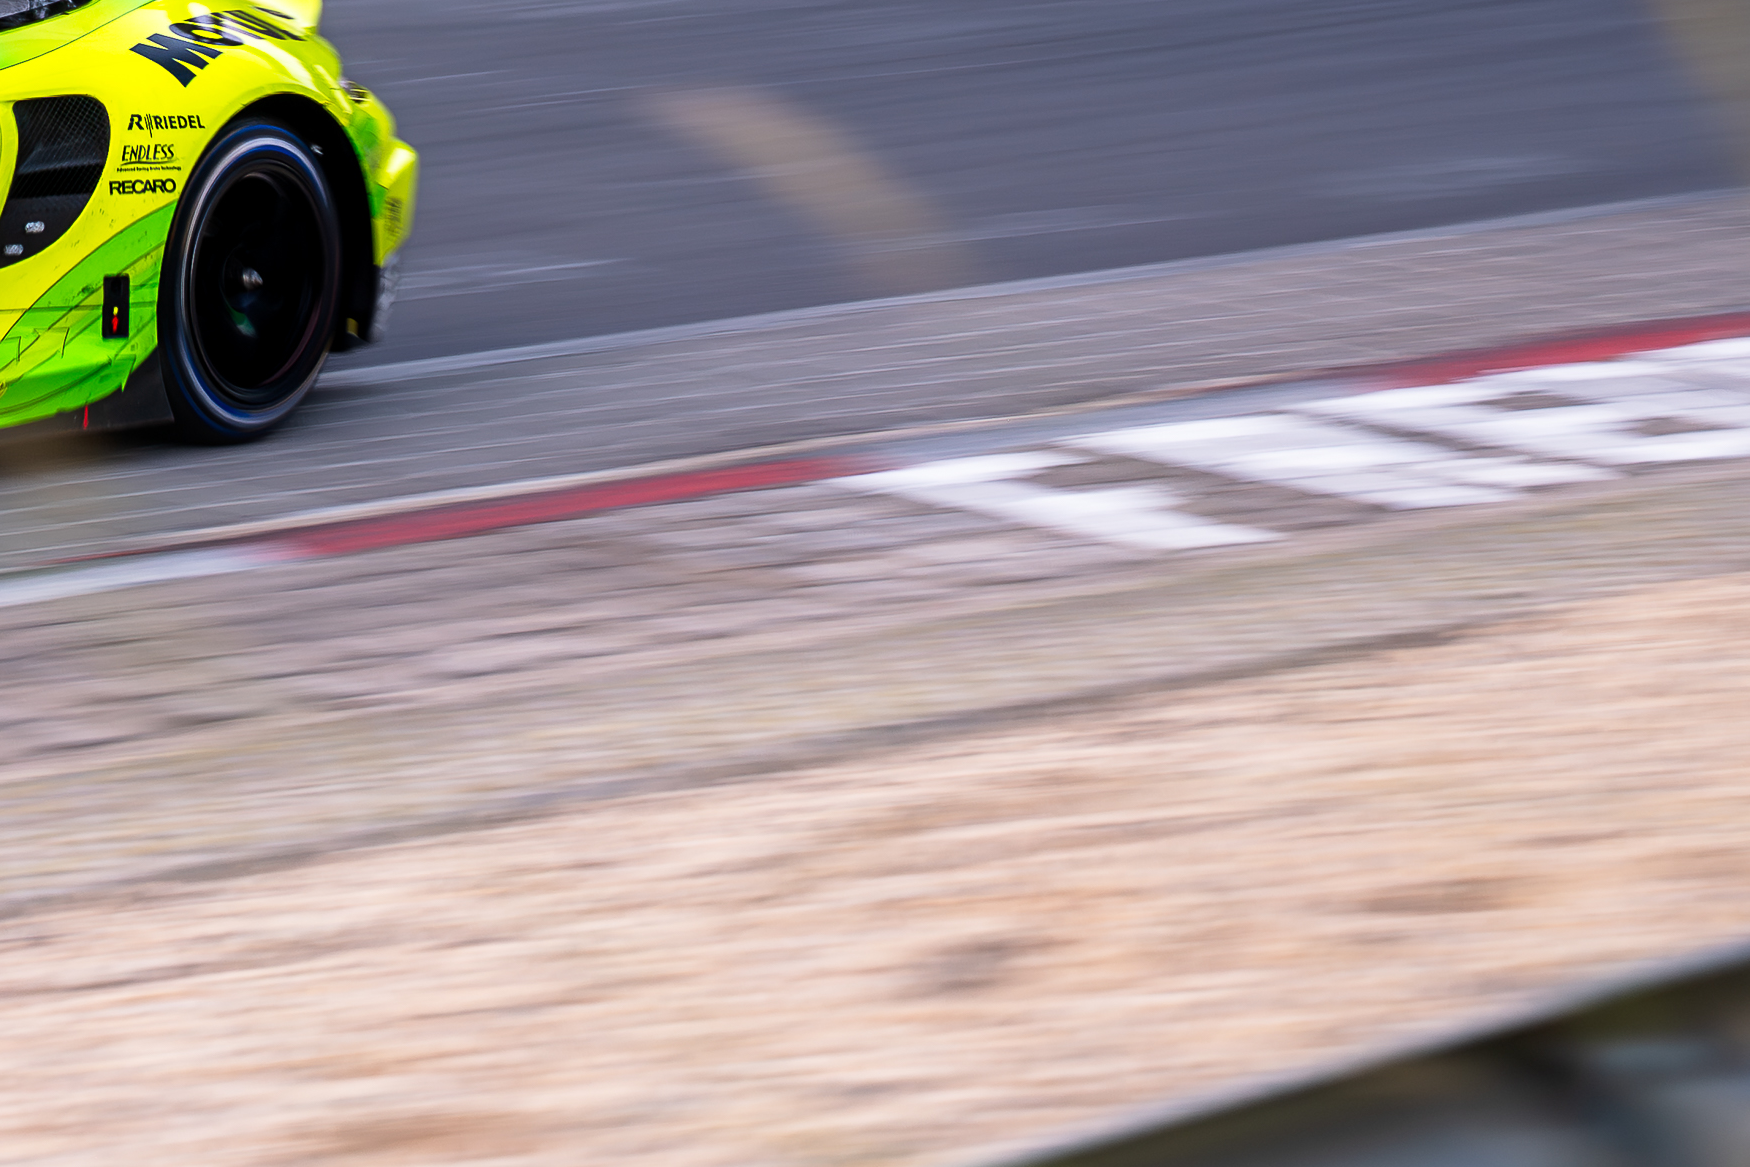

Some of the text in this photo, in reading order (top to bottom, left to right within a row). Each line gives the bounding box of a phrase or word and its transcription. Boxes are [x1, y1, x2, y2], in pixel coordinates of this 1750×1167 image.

[152, 115, 206, 130] RIEDEL
[121, 143, 176, 162] ENDLESS
[109, 178, 177, 196] RECARO
